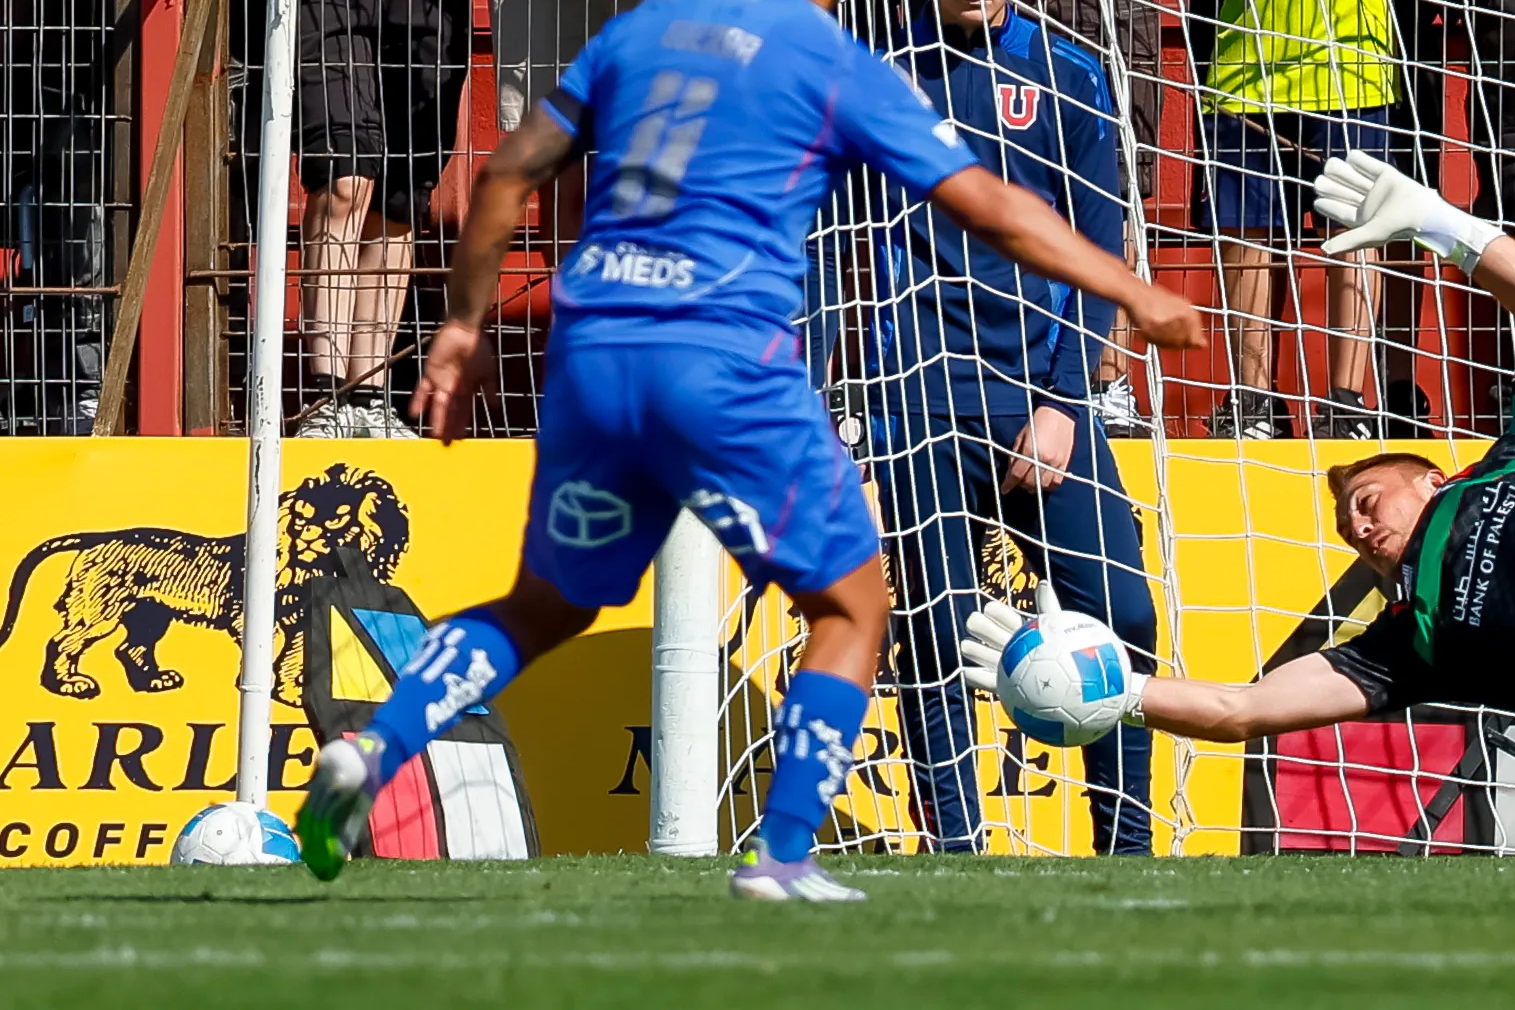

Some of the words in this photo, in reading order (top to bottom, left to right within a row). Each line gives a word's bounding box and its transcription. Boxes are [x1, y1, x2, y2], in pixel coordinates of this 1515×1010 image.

[997, 84, 1040, 130] U
[601, 250, 697, 289] MEDS
[1468, 577, 1490, 627] BANK
[1479, 548, 1497, 575] OF
